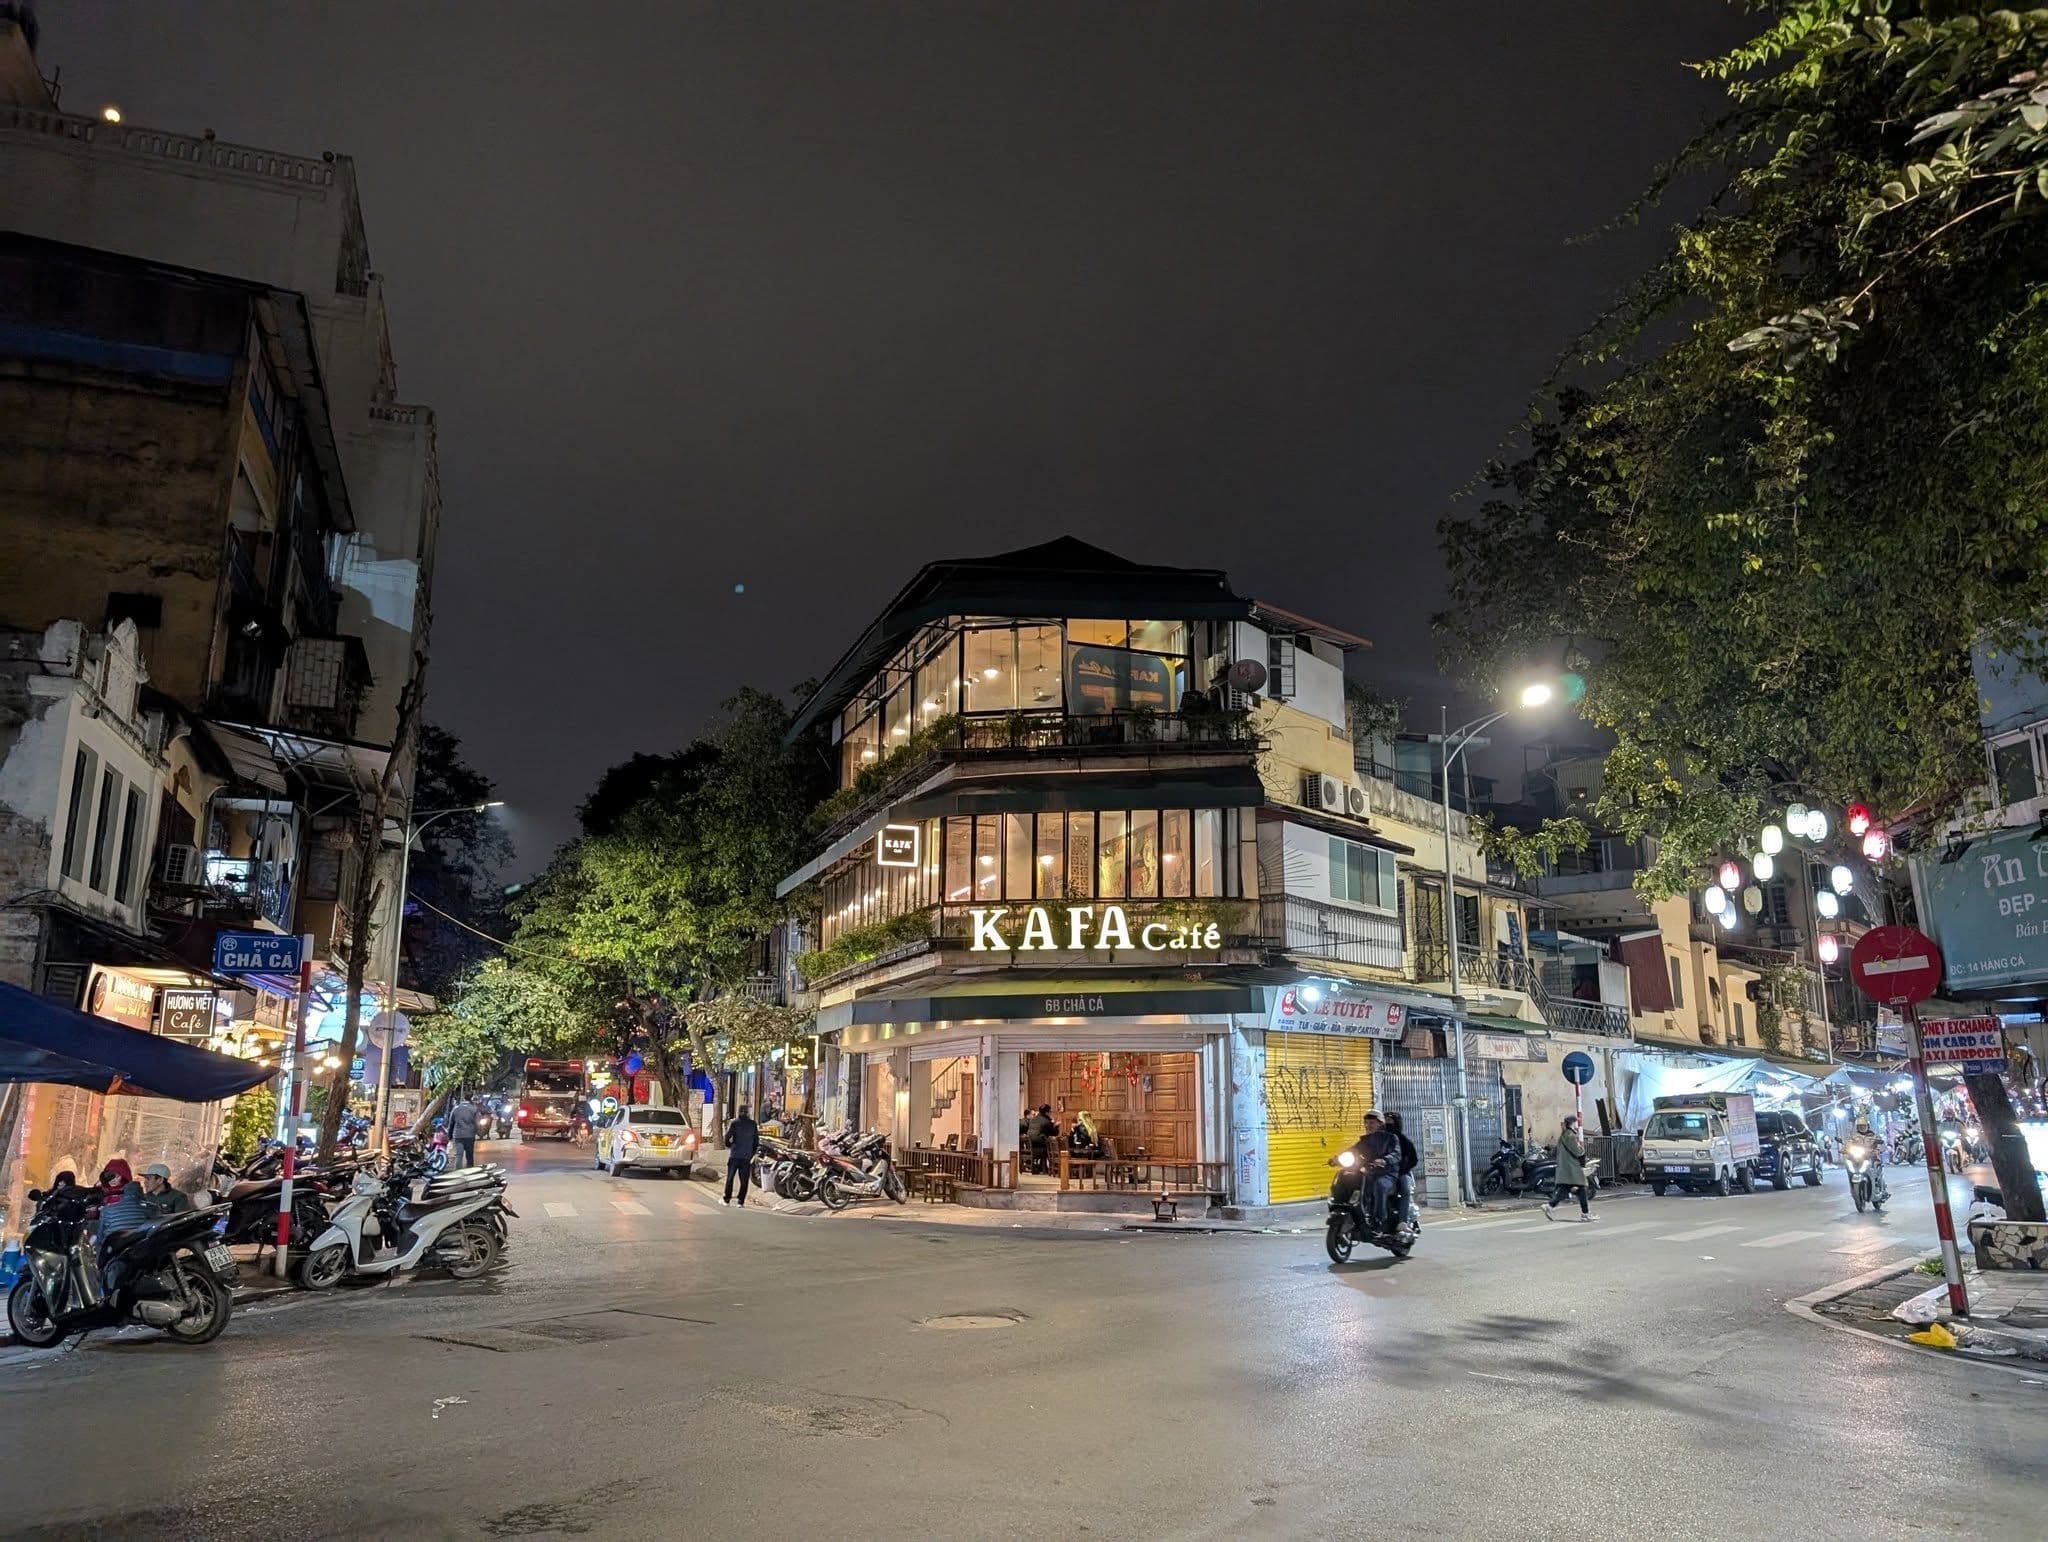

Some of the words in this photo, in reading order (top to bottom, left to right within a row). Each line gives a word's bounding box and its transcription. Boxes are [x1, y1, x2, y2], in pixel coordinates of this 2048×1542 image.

[1998, 893, 2035, 917] ĐẸP
[969, 905, 1135, 952] KAFA
[1141, 922, 1222, 951] Café
[2015, 922, 2039, 939] Bán
[224, 949, 263, 968] CHẢ
[268, 951, 294, 969] CÁ
[1968, 962, 1979, 973] 14
[167, 995, 195, 1010] HƯƠNG
[195, 994, 212, 1013] VIỆT
[1045, 999, 1060, 1012] 6B
[1063, 994, 1087, 1012] CHẢ
[1088, 995, 1105, 1012] CÁ
[170, 1011, 204, 1034] Café
[1920, 1020, 1945, 1036] ONEY
[1948, 1018, 1999, 1034] EXCHANGE
[1943, 1036, 1976, 1048] CARD
[1923, 1050, 1946, 1061] AXI
[1948, 1047, 2001, 1060] AIRPORT
